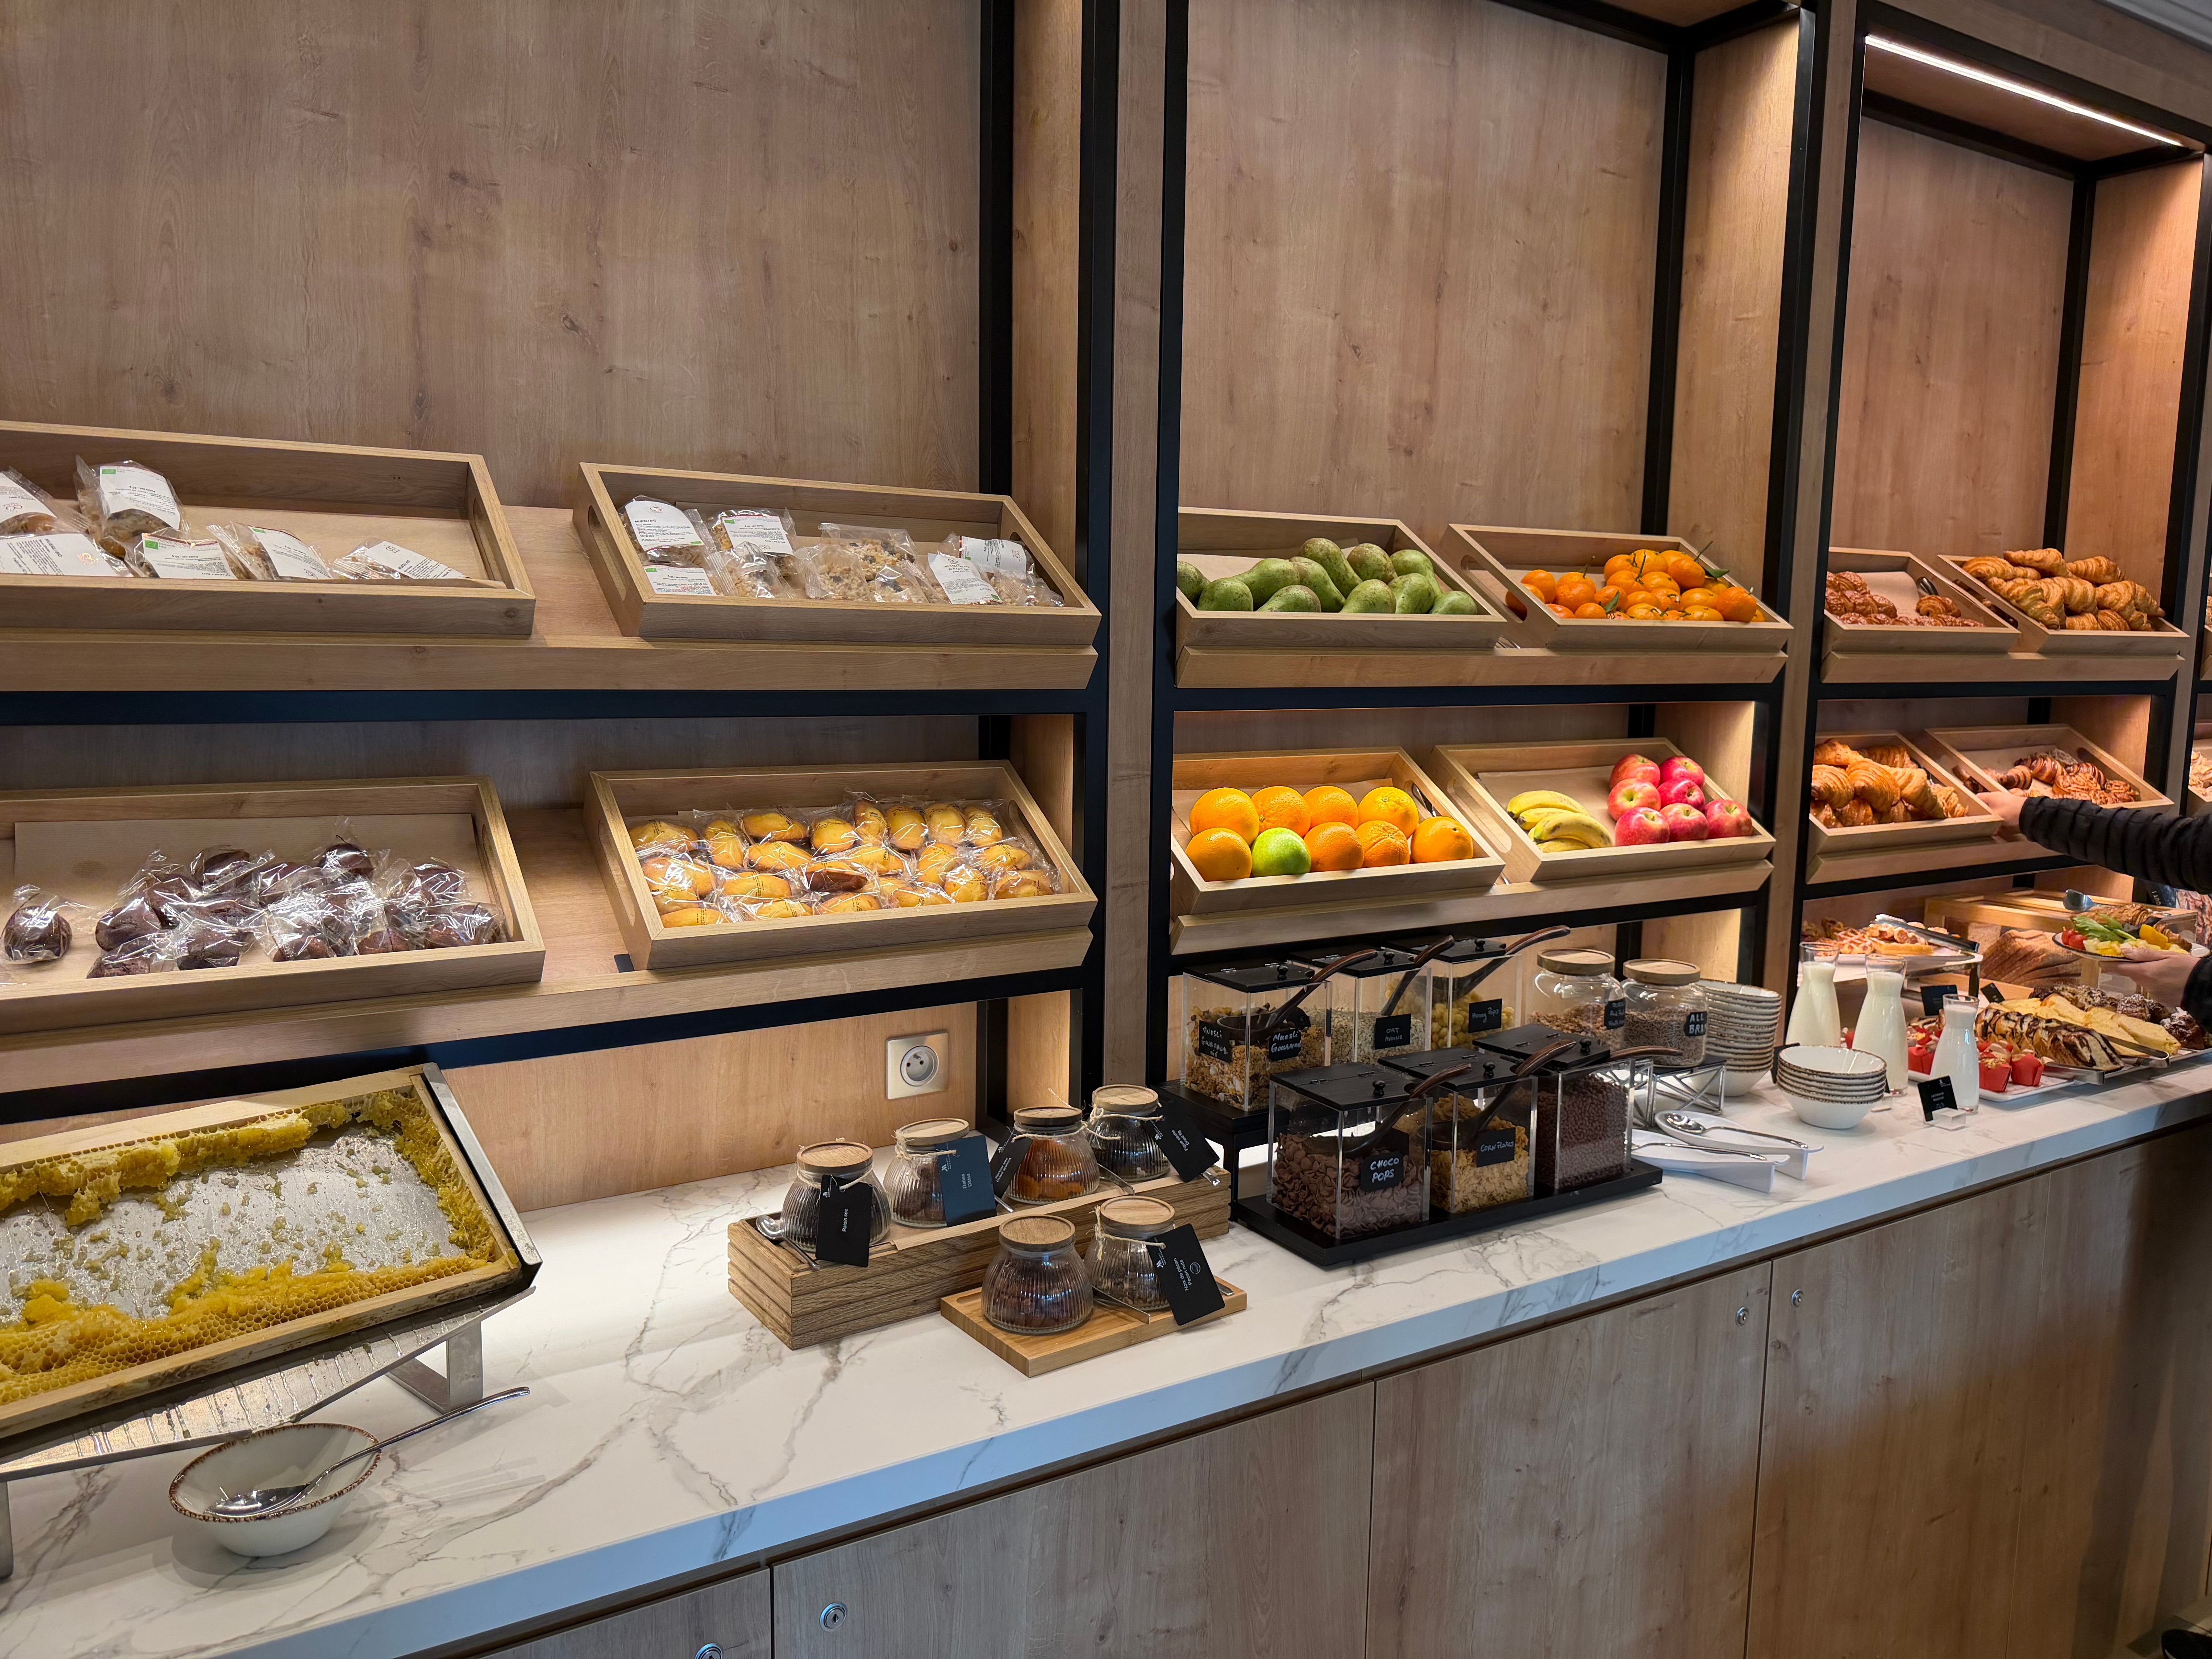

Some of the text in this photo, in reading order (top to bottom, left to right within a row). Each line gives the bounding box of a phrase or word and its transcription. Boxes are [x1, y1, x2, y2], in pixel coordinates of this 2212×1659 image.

[1690, 1013, 1704, 1023] ALL
[1370, 1158, 1400, 1171] CHOCO
[1372, 1169, 1395, 1183] POPS
[1184, 1270, 1193, 1286] Pecan
[1182, 1279, 1193, 1291] Noix
